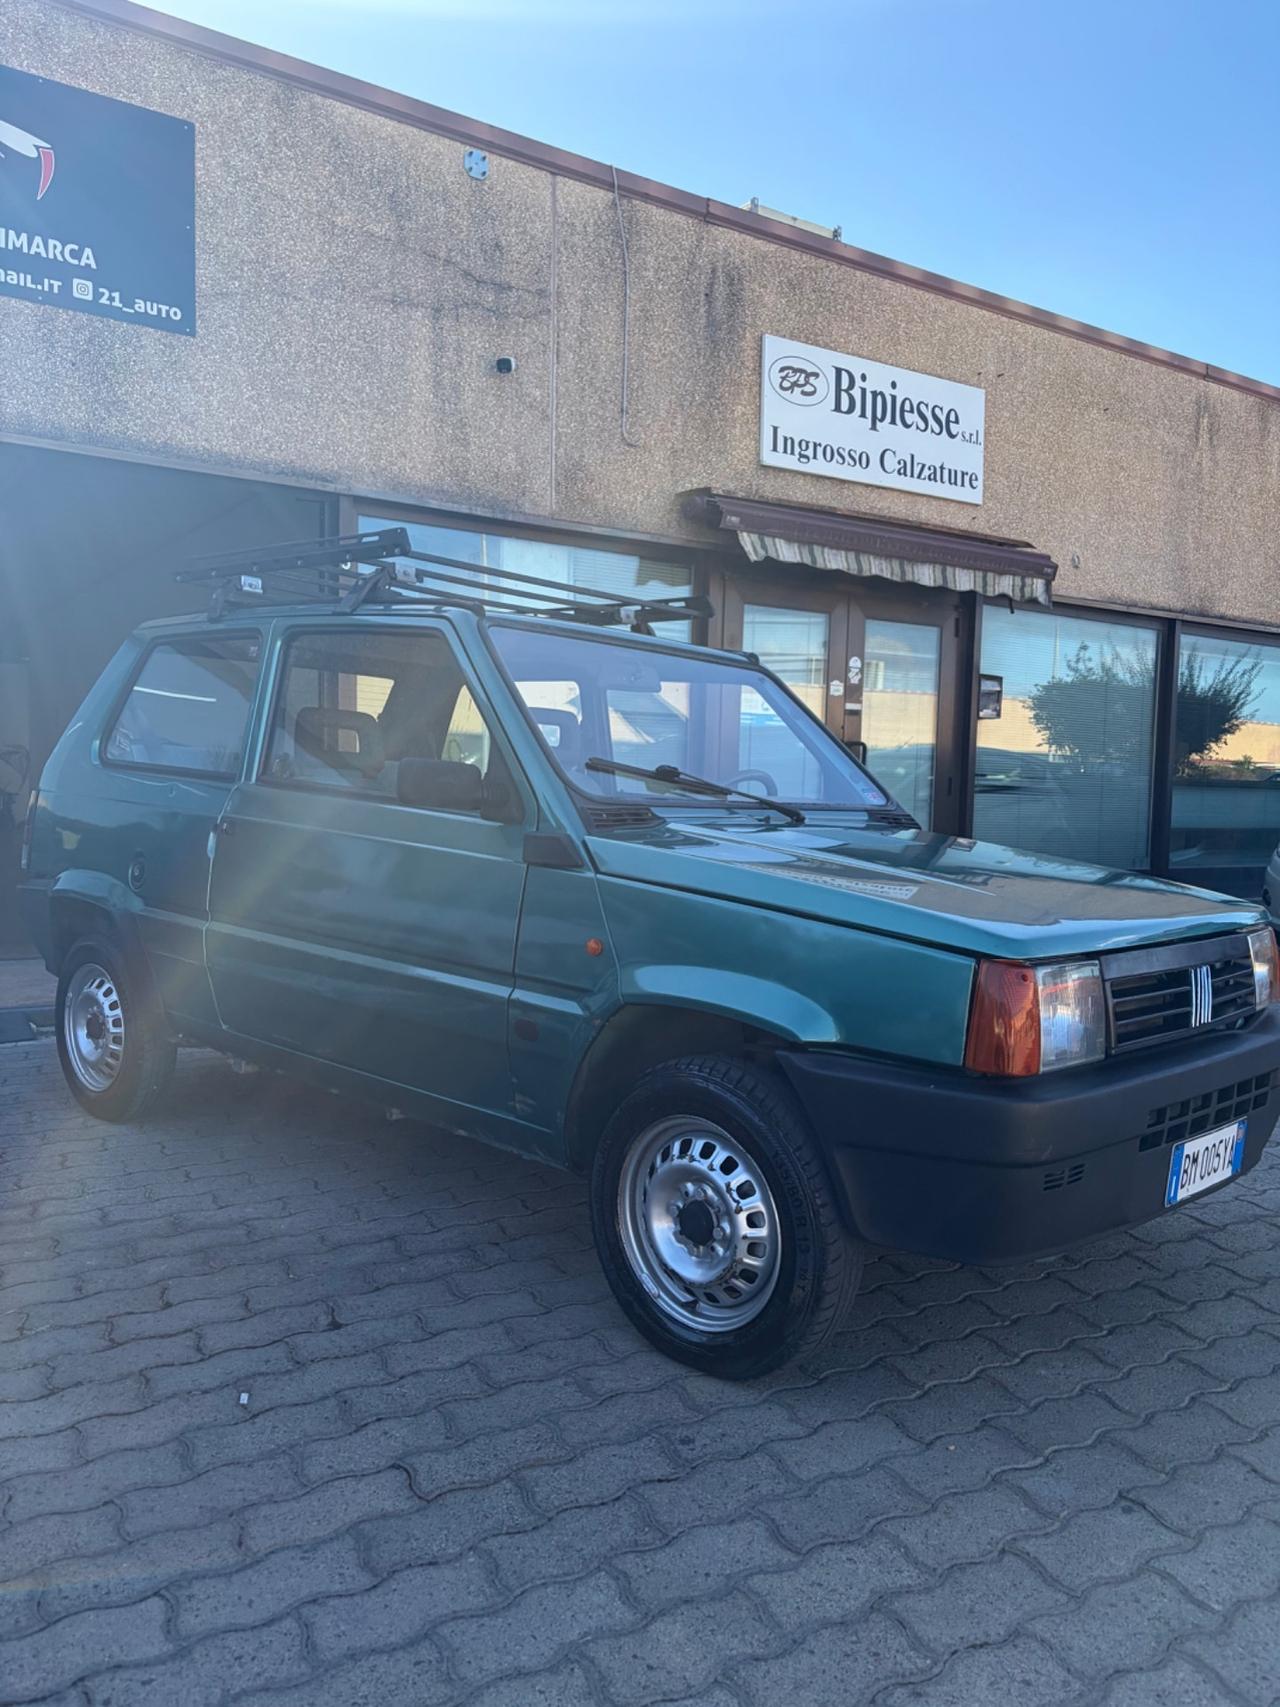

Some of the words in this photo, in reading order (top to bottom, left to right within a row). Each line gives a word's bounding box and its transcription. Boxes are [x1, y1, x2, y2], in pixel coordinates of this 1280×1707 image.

[830, 364, 961, 440] Bipiesse
[960, 429, 982, 446] s.r.l.
[770, 424, 870, 470] Ingrosso
[879, 447, 979, 490] Calzature
